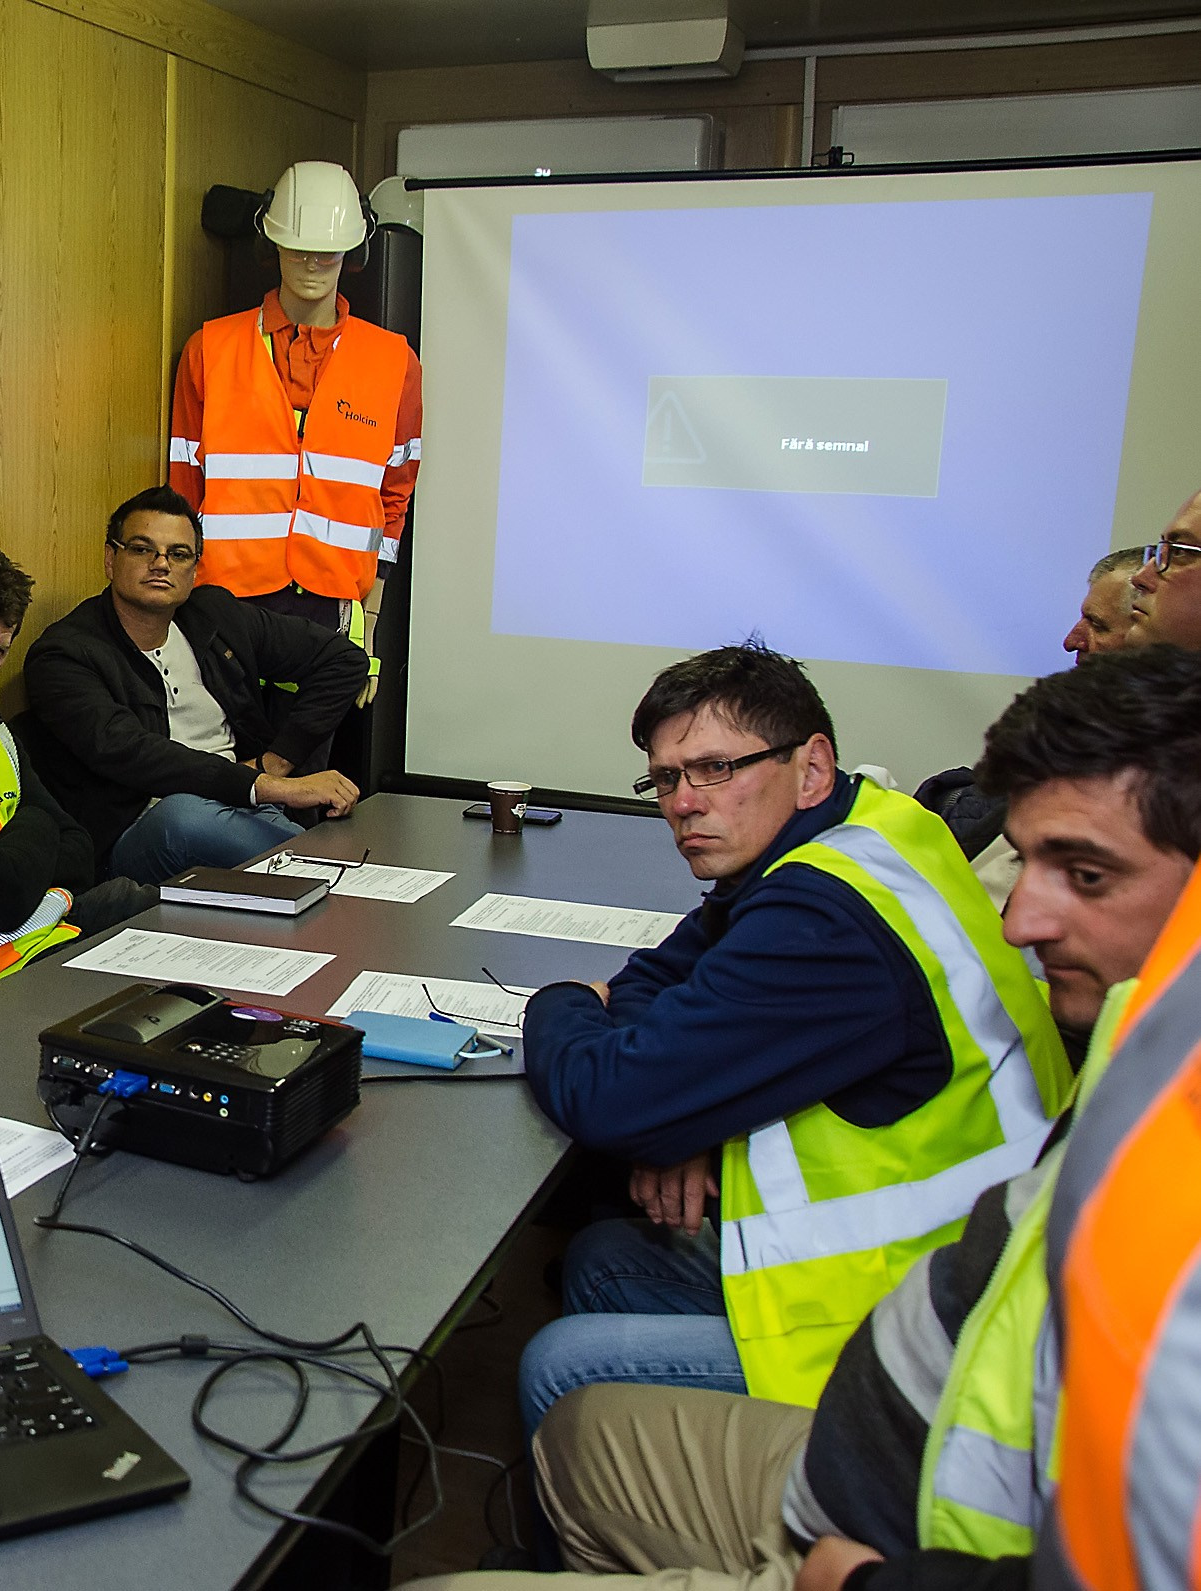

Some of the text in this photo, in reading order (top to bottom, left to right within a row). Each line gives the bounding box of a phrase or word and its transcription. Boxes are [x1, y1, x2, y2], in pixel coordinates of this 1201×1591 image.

[345, 411, 377, 427] Holcim
[781, 437, 870, 452] Fără semnal
